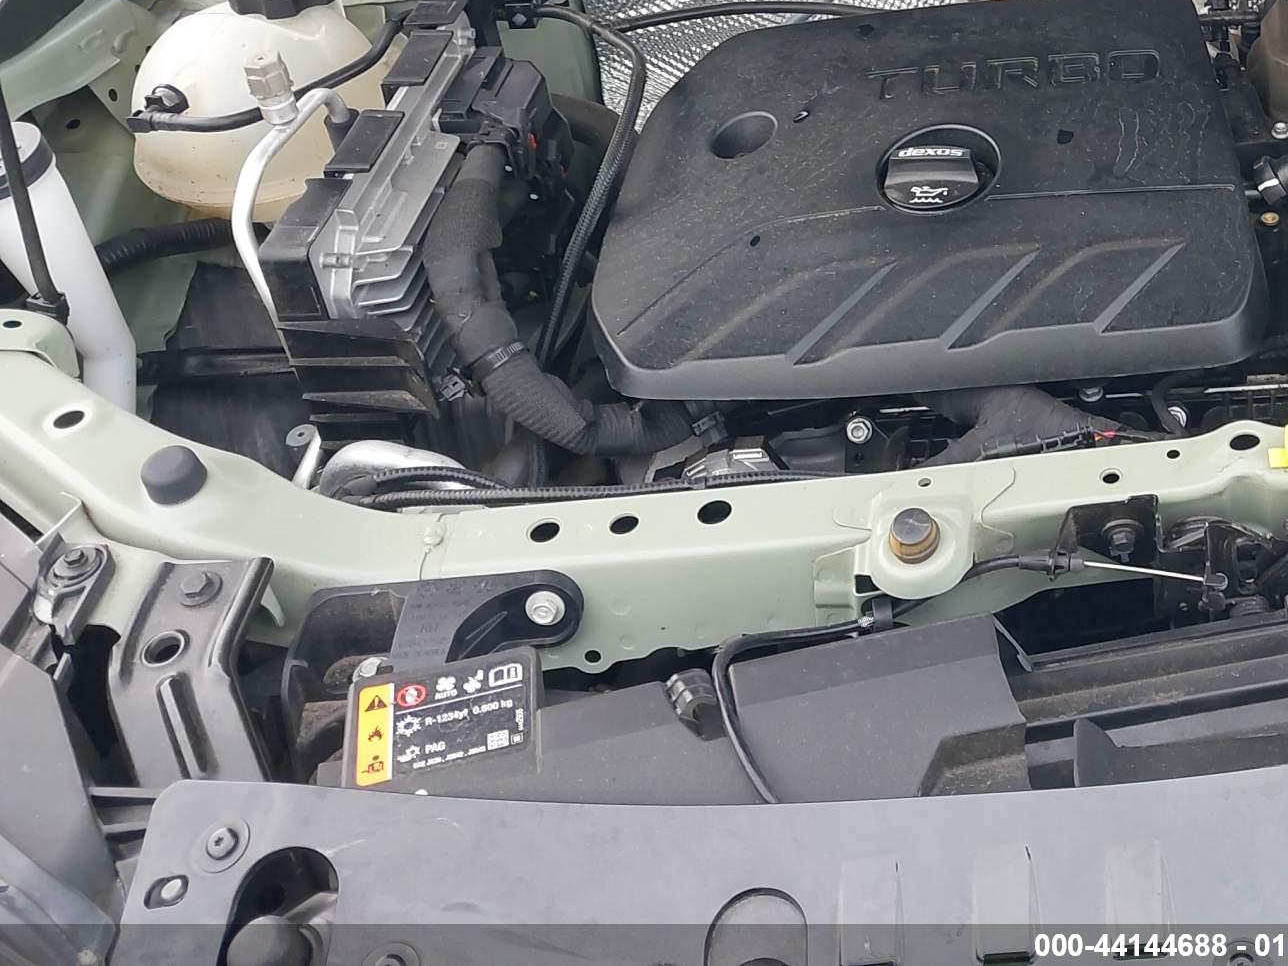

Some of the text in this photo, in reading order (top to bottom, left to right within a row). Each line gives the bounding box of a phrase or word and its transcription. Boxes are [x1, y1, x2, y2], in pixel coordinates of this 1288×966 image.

[866, 49, 1161, 100] TURBO
[898, 147, 964, 158] dexos
[434, 689, 458, 700] AUTO
[424, 709, 469, 726] R-1234yf
[501, 699, 513, 709] kg
[425, 741, 446, 754] PAG
